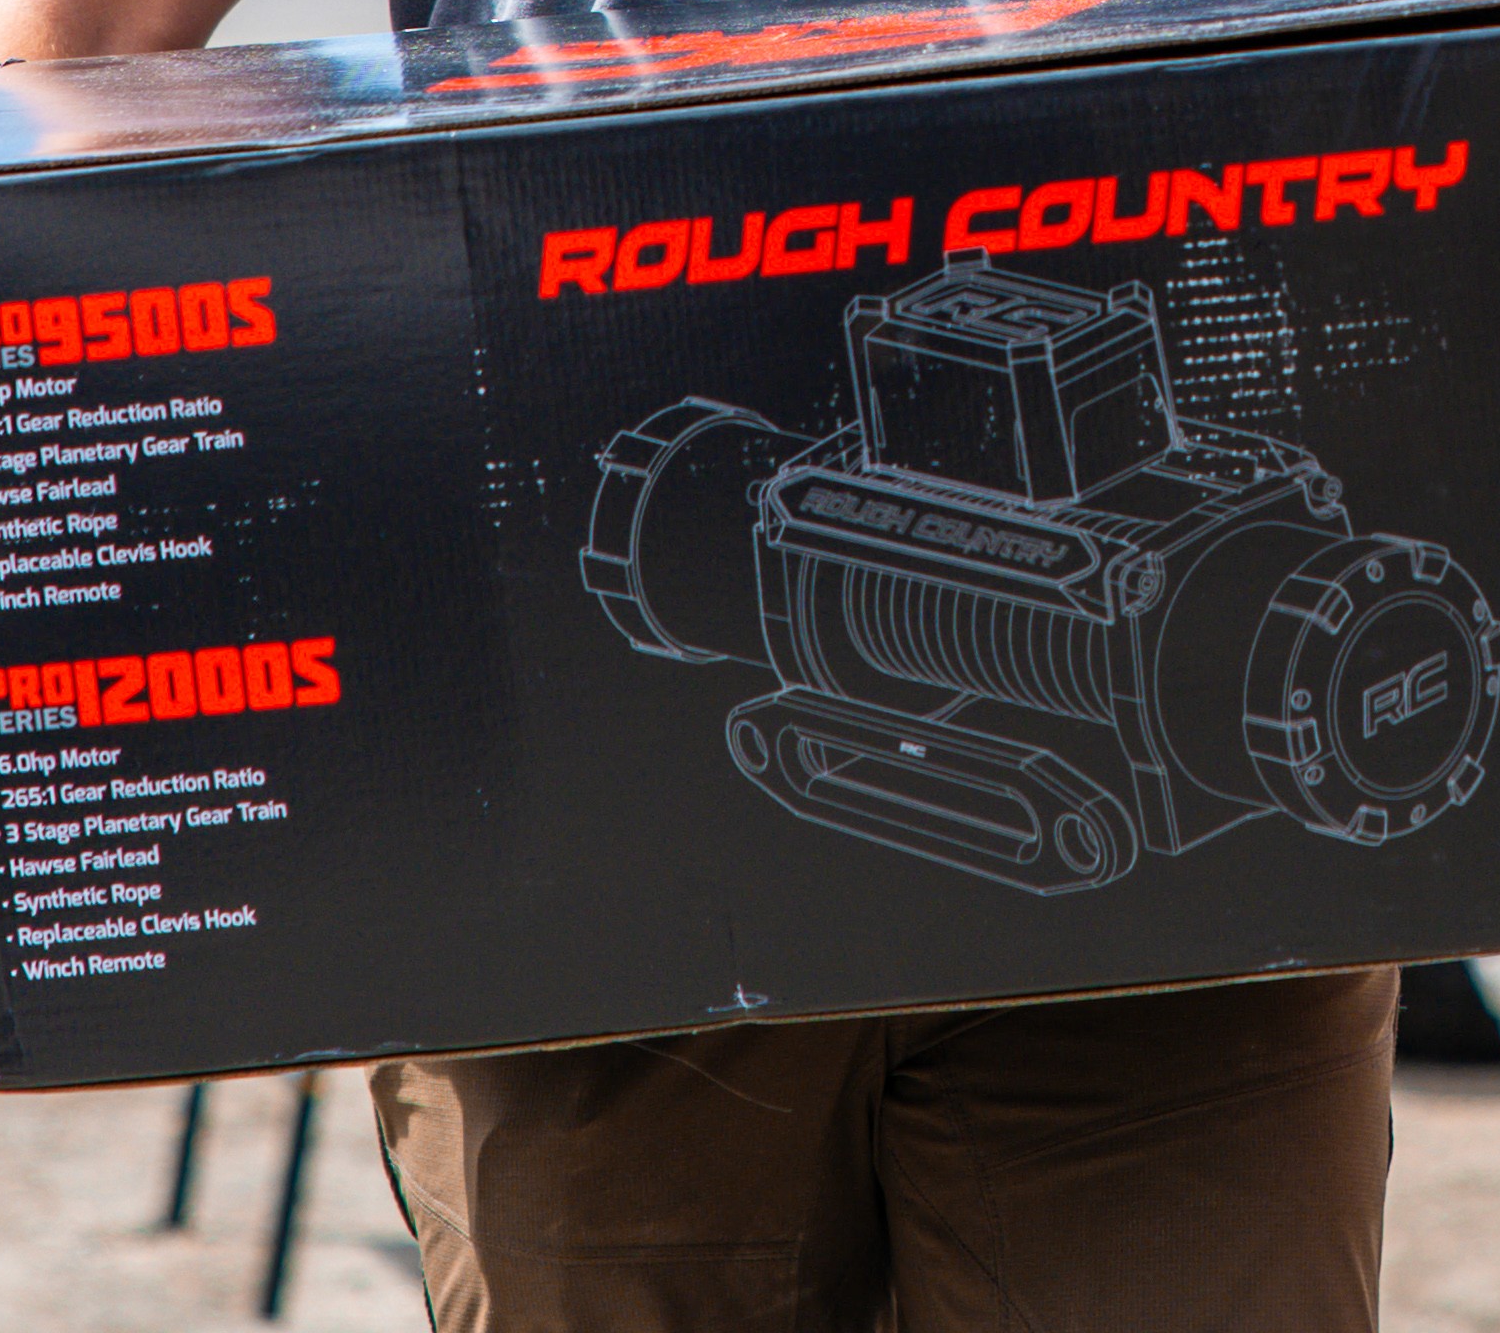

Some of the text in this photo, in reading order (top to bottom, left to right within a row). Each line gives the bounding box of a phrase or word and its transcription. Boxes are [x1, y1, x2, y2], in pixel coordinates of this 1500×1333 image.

[538, 140, 1470, 299] ROUGH COUNTRY
[15, 377, 77, 400] Motor
[16, 413, 63, 434] Gear
[67, 402, 166, 429] Reduction
[169, 395, 222, 419] Ratio
[40, 440, 138, 465] Planetary
[142, 436, 190, 457] Gear
[194, 429, 244, 452] Train
[36, 474, 116, 502] Fairlead
[67, 513, 118, 537] Rope
[799, 486, 1070, 568] ROUGH COUNTRY
[96, 542, 156, 566] Clevis
[160, 535, 213, 560] Hook
[43, 581, 122, 605] Remote
[1363, 650, 1448, 740] RC
[60, 747, 122, 770] Motor
[1, 766, 266, 810] 265:1 Gear Reduction Ratio
[5, 799, 288, 845] 3 Stage Planetary Gear Train
[9, 844, 160, 878] Hawse Fairlead
[13, 883, 162, 917] Synthetic Rope
[17, 904, 257, 950] Replaceable Clevis Hook
[22, 951, 166, 981] Winch Remote
